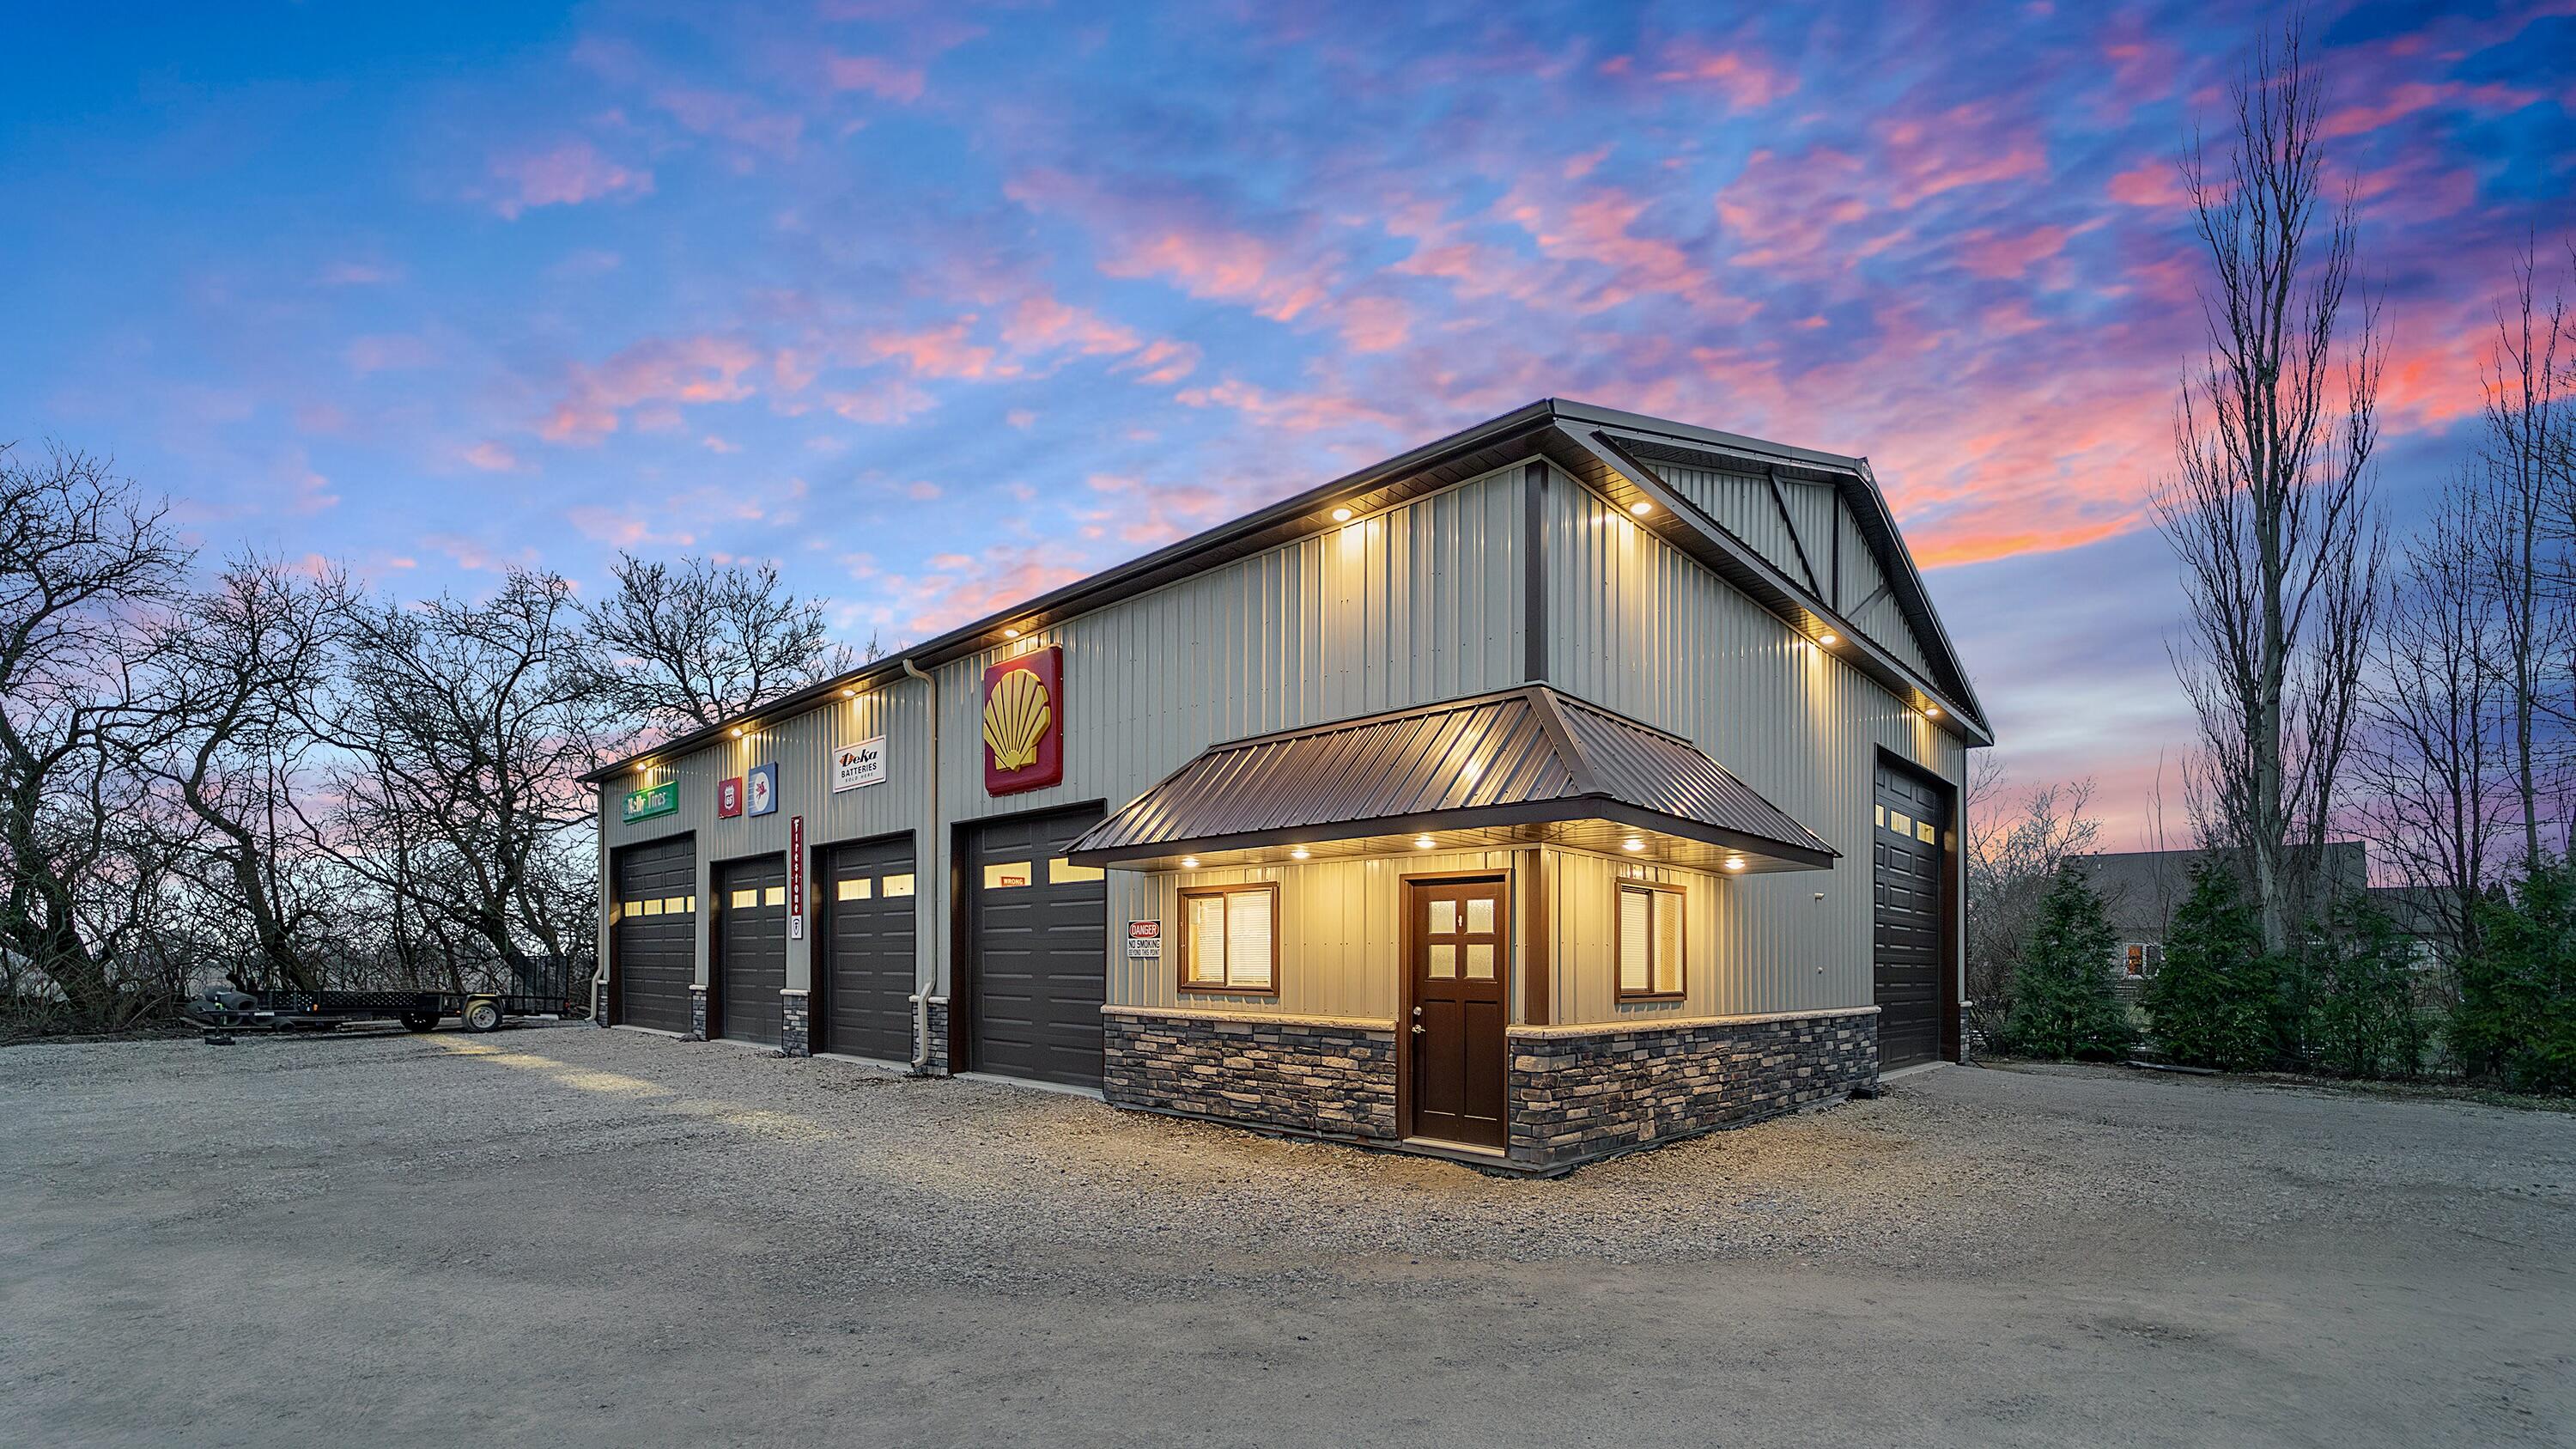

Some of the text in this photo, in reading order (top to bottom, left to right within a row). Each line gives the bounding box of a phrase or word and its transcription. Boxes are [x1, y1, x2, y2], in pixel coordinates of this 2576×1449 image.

[841, 749, 878, 767] Deka
[841, 763, 877, 777] BATTERIES
[628, 791, 666, 814] Kelly Tires
[1132, 924, 1157, 935] DANGER
[1128, 940, 1160, 948] NO SMOKING
